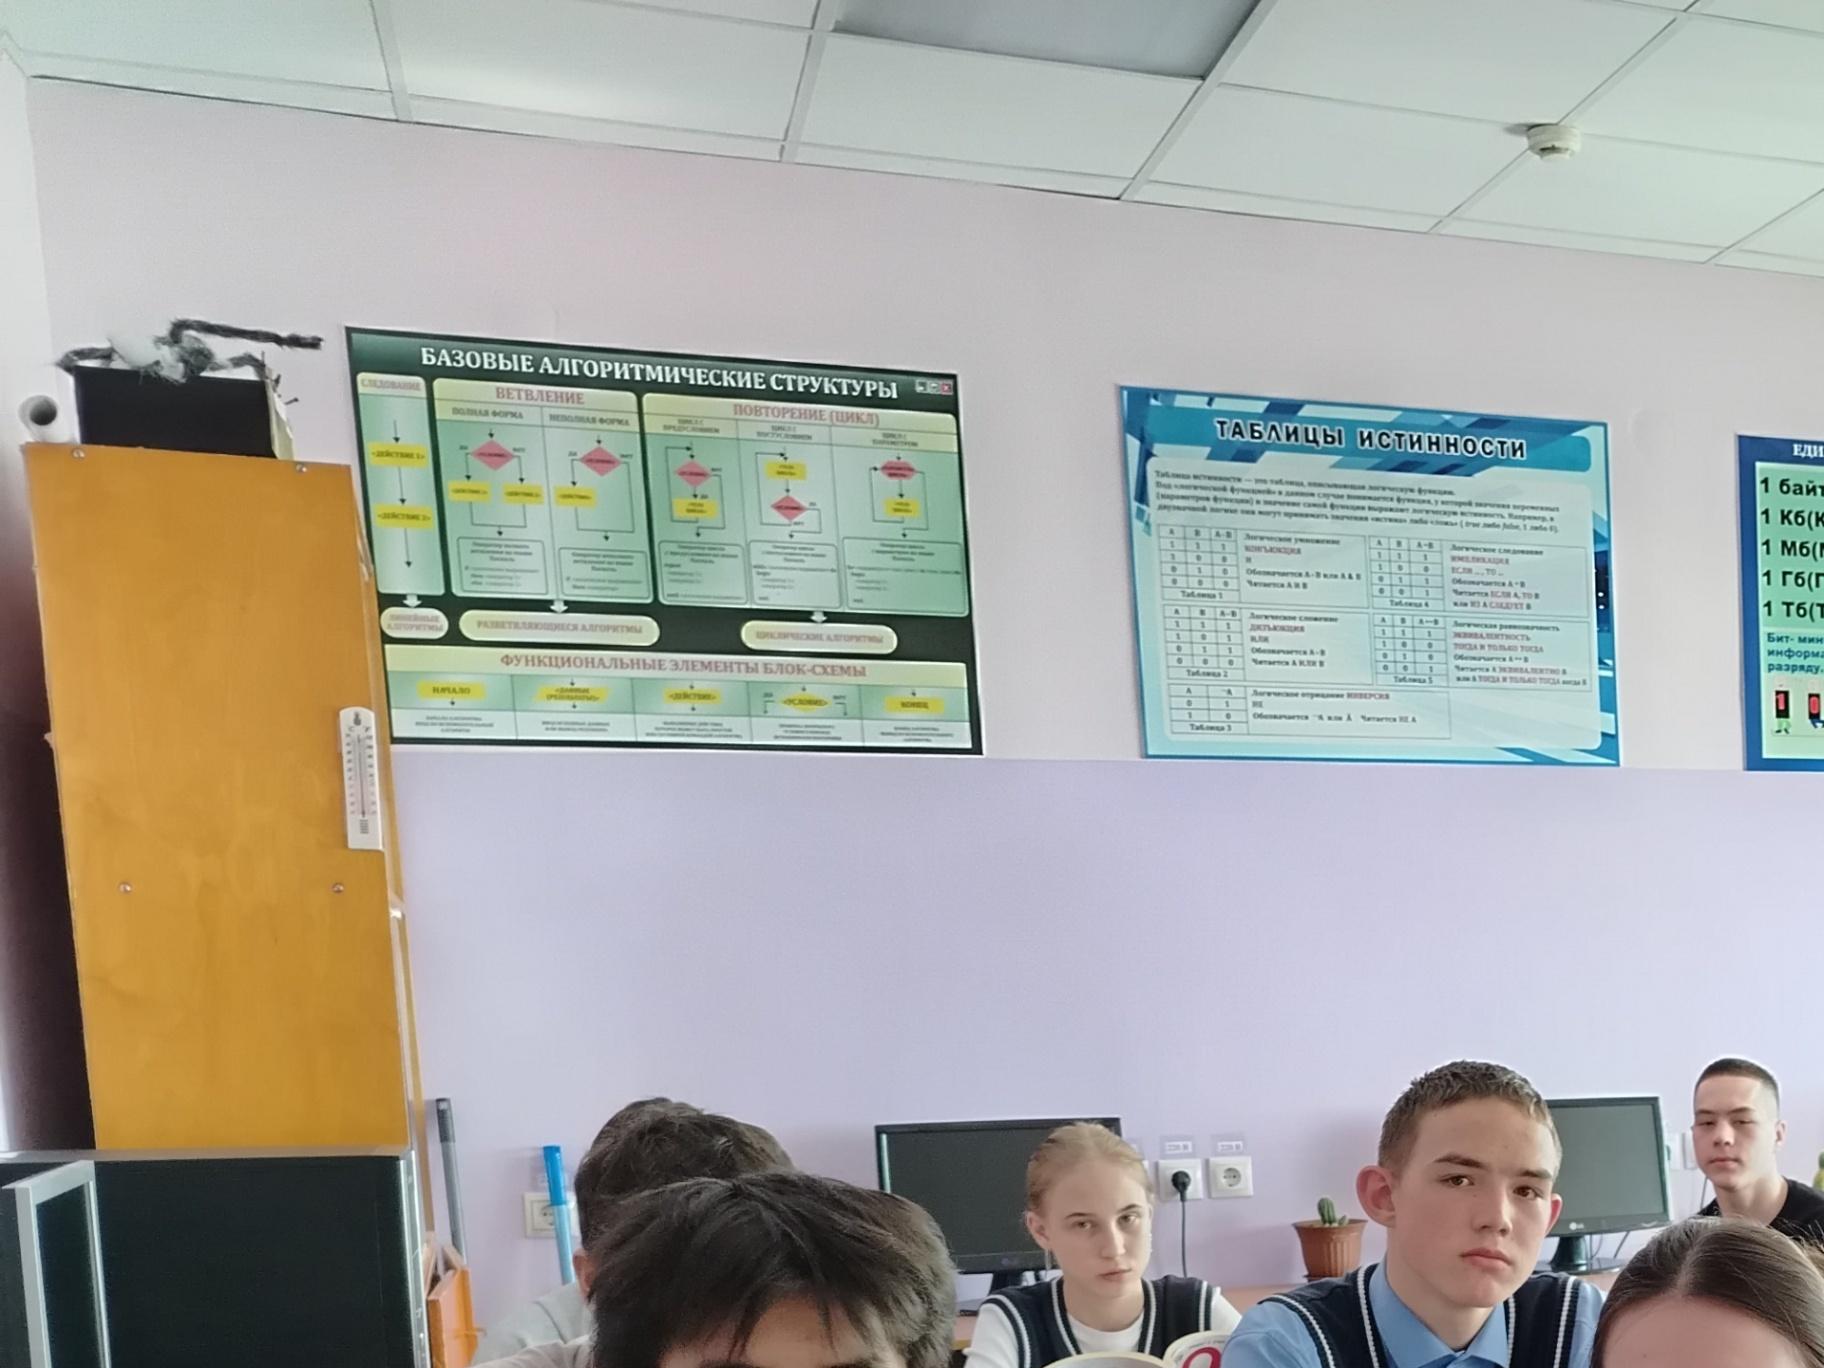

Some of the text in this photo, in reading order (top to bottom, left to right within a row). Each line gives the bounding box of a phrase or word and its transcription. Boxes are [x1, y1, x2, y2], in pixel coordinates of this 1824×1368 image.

[419, 346, 898, 400] БАЗОВЫЕ АЛГОРИТМИЧЕСКИЕ СТРУКТУРЫ
[360, 377, 421, 392] СЛЕДОВАНИЕ
[494, 386, 584, 405] ВЕТВЛЕНИЕ
[450, 406, 523, 420] ПОЛНАЯ ФОРМА
[549, 413, 630, 427] НЕПОЛНАЯ ФОРМА
[732, 402, 880, 427] ПОВТОРЕНИЕ (ЦИКЛ)
[1215, 418, 1526, 459] ТАБЛИЦЫ ИСТИННОСТИ
[1760, 478, 1769, 493] 1
[1761, 509, 1770, 523] 1
[1761, 540, 1770, 554] 1
[1762, 571, 1771, 585] 1
[1763, 601, 1772, 615] 1
[386, 622, 443, 632] АЛГОРИТМЫ
[580, 623, 642, 634] АЛГОРИТМЫ
[755, 630, 883, 644] ЦИКЛИЧЕСКИЕ АЛГОРИТМЫ
[499, 653, 866, 678] ФУНКЦИОНАЛЬНЫЕ ЭЛЕМЕНТЫ БЛОК-СХЕМЫ
[1767, 661, 1824, 674] разряду.
[431, 685, 470, 694] НАЧАЛО
